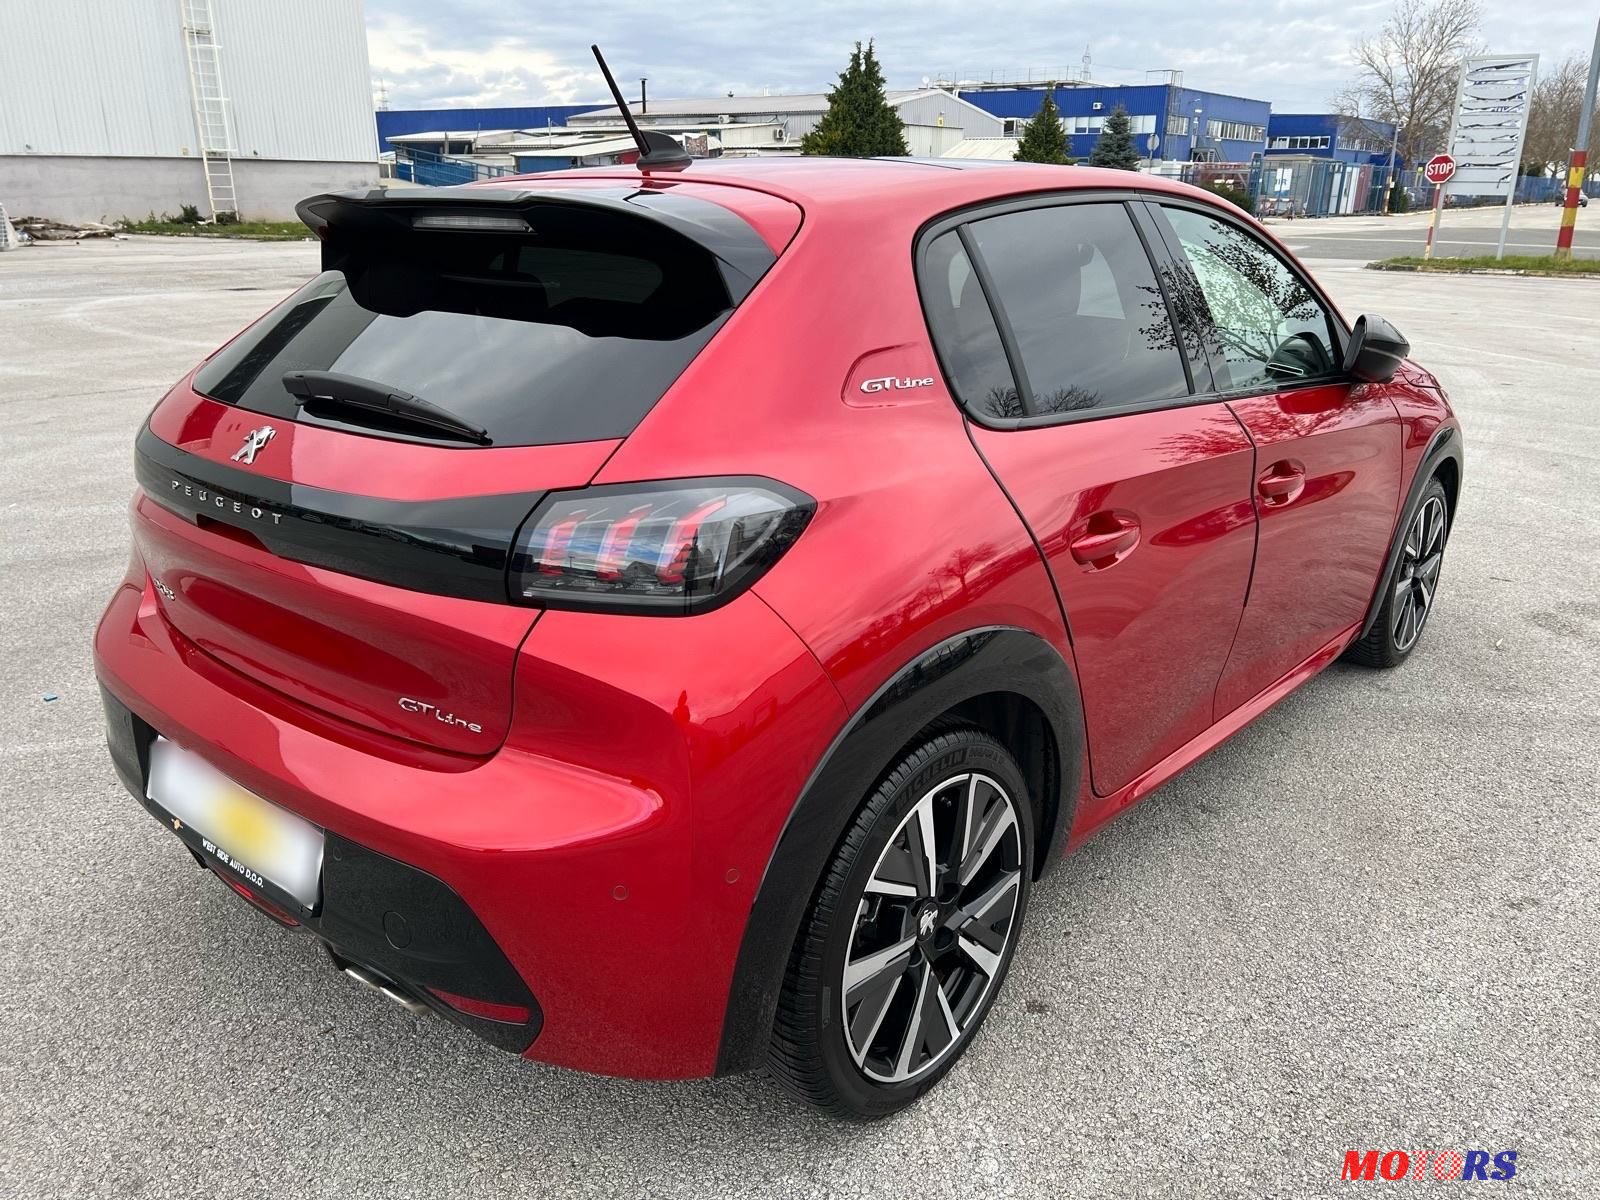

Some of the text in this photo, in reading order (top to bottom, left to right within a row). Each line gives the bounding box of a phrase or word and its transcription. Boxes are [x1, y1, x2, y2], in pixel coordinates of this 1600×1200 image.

[1427, 162, 1454, 176] STOP
[860, 376, 934, 393] GT Line
[171, 480, 283, 525] PEUGEOT
[398, 697, 482, 734] GT Line
[893, 748, 967, 816] MICHELIN
[202, 837, 264, 889] WEST SIDE AUTO D.O.O.
